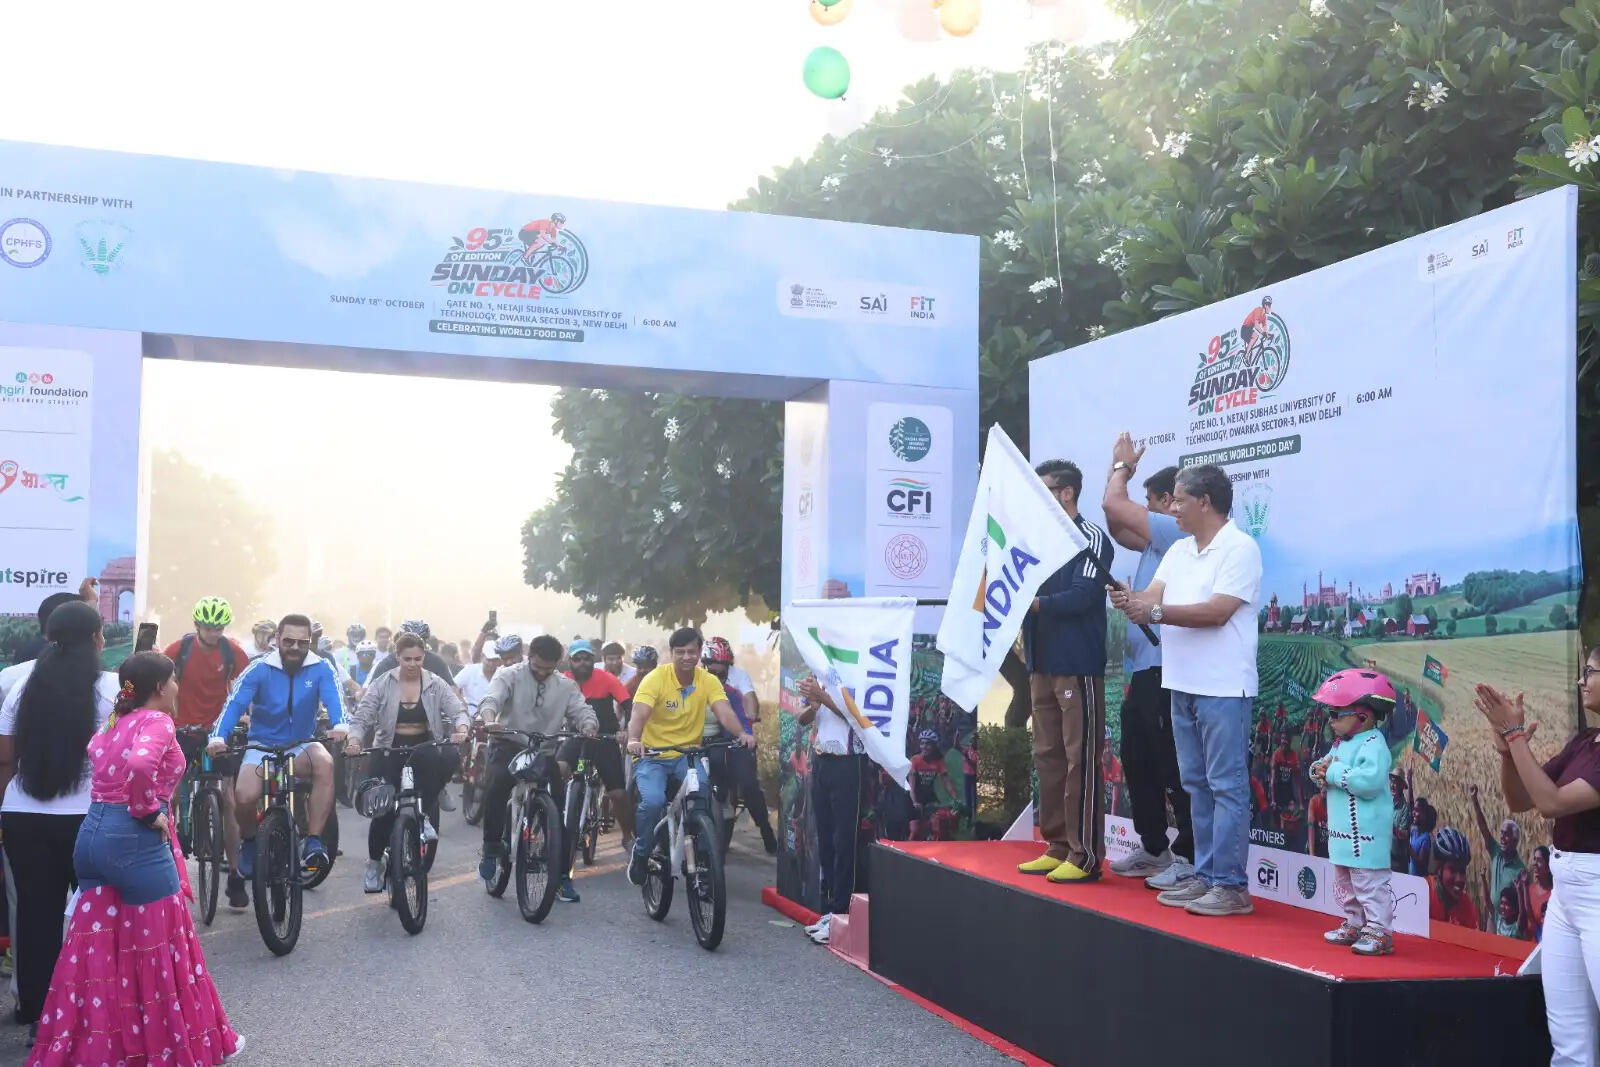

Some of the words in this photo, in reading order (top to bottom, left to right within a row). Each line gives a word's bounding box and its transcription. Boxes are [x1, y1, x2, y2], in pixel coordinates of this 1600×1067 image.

[0, 187, 13, 198] IN
[16, 189, 99, 206] PARTNERSHIP
[102, 198, 133, 209] WITH
[6, 237, 43, 249] CPHFS
[1507, 240, 1524, 250] INDIA
[464, 252, 502, 261] EDITION
[430, 263, 546, 285] SUNDAY
[329, 294, 366, 305] SUNDAY
[385, 299, 425, 310] OCTOBER
[446, 299, 467, 309] GATE
[496, 303, 524, 314] NETAJI
[526, 305, 559, 315] SUBHAS
[561, 308, 610, 319] UNIVERSITY
[499, 313, 538, 323] DWARKA
[582, 319, 602, 328] NEW
[604, 320, 628, 330] DELHI
[642, 318, 661, 327] 6:00
[662, 319, 677, 328] AM
[910, 311, 935, 320] INDIA
[436, 322, 497, 335] CELEBRATING
[499, 327, 531, 337] WORLD
[533, 329, 557, 339] FOOD
[559, 331, 577, 340] DAY
[30, 386, 88, 398] foundation
[1188, 366, 1260, 406] SUNDAY
[1356, 390, 1376, 404] 6:00
[1377, 386, 1393, 400] AM
[1190, 420, 1206, 434] GATE
[1226, 412, 1249, 425] NETAJI
[1249, 404, 1278, 419] SUBHAS
[1279, 394, 1324, 413] UNIVERSITY
[1325, 391, 1337, 404] OF
[1229, 422, 1260, 438] DWARKA
[1298, 411, 1317, 425] NEW
[1318, 405, 1342, 421] DELHI
[1149, 432, 1176, 446] OCTOBER
[1183, 452, 1228, 468] CELEBRATING
[1229, 446, 1255, 460] WORLD
[1256, 443, 1277, 456] FOOD
[1278, 439, 1295, 452] DAY
[1228, 471, 1252, 483] ERSHIP
[1252, 468, 1270, 480] WITH
[886, 489, 932, 514] CFI
[982, 546, 1041, 660] NDIA
[863, 638, 899, 738] NDIA
[1249, 828, 1285, 845] ARTNERS
[1257, 867, 1279, 887] CFI
